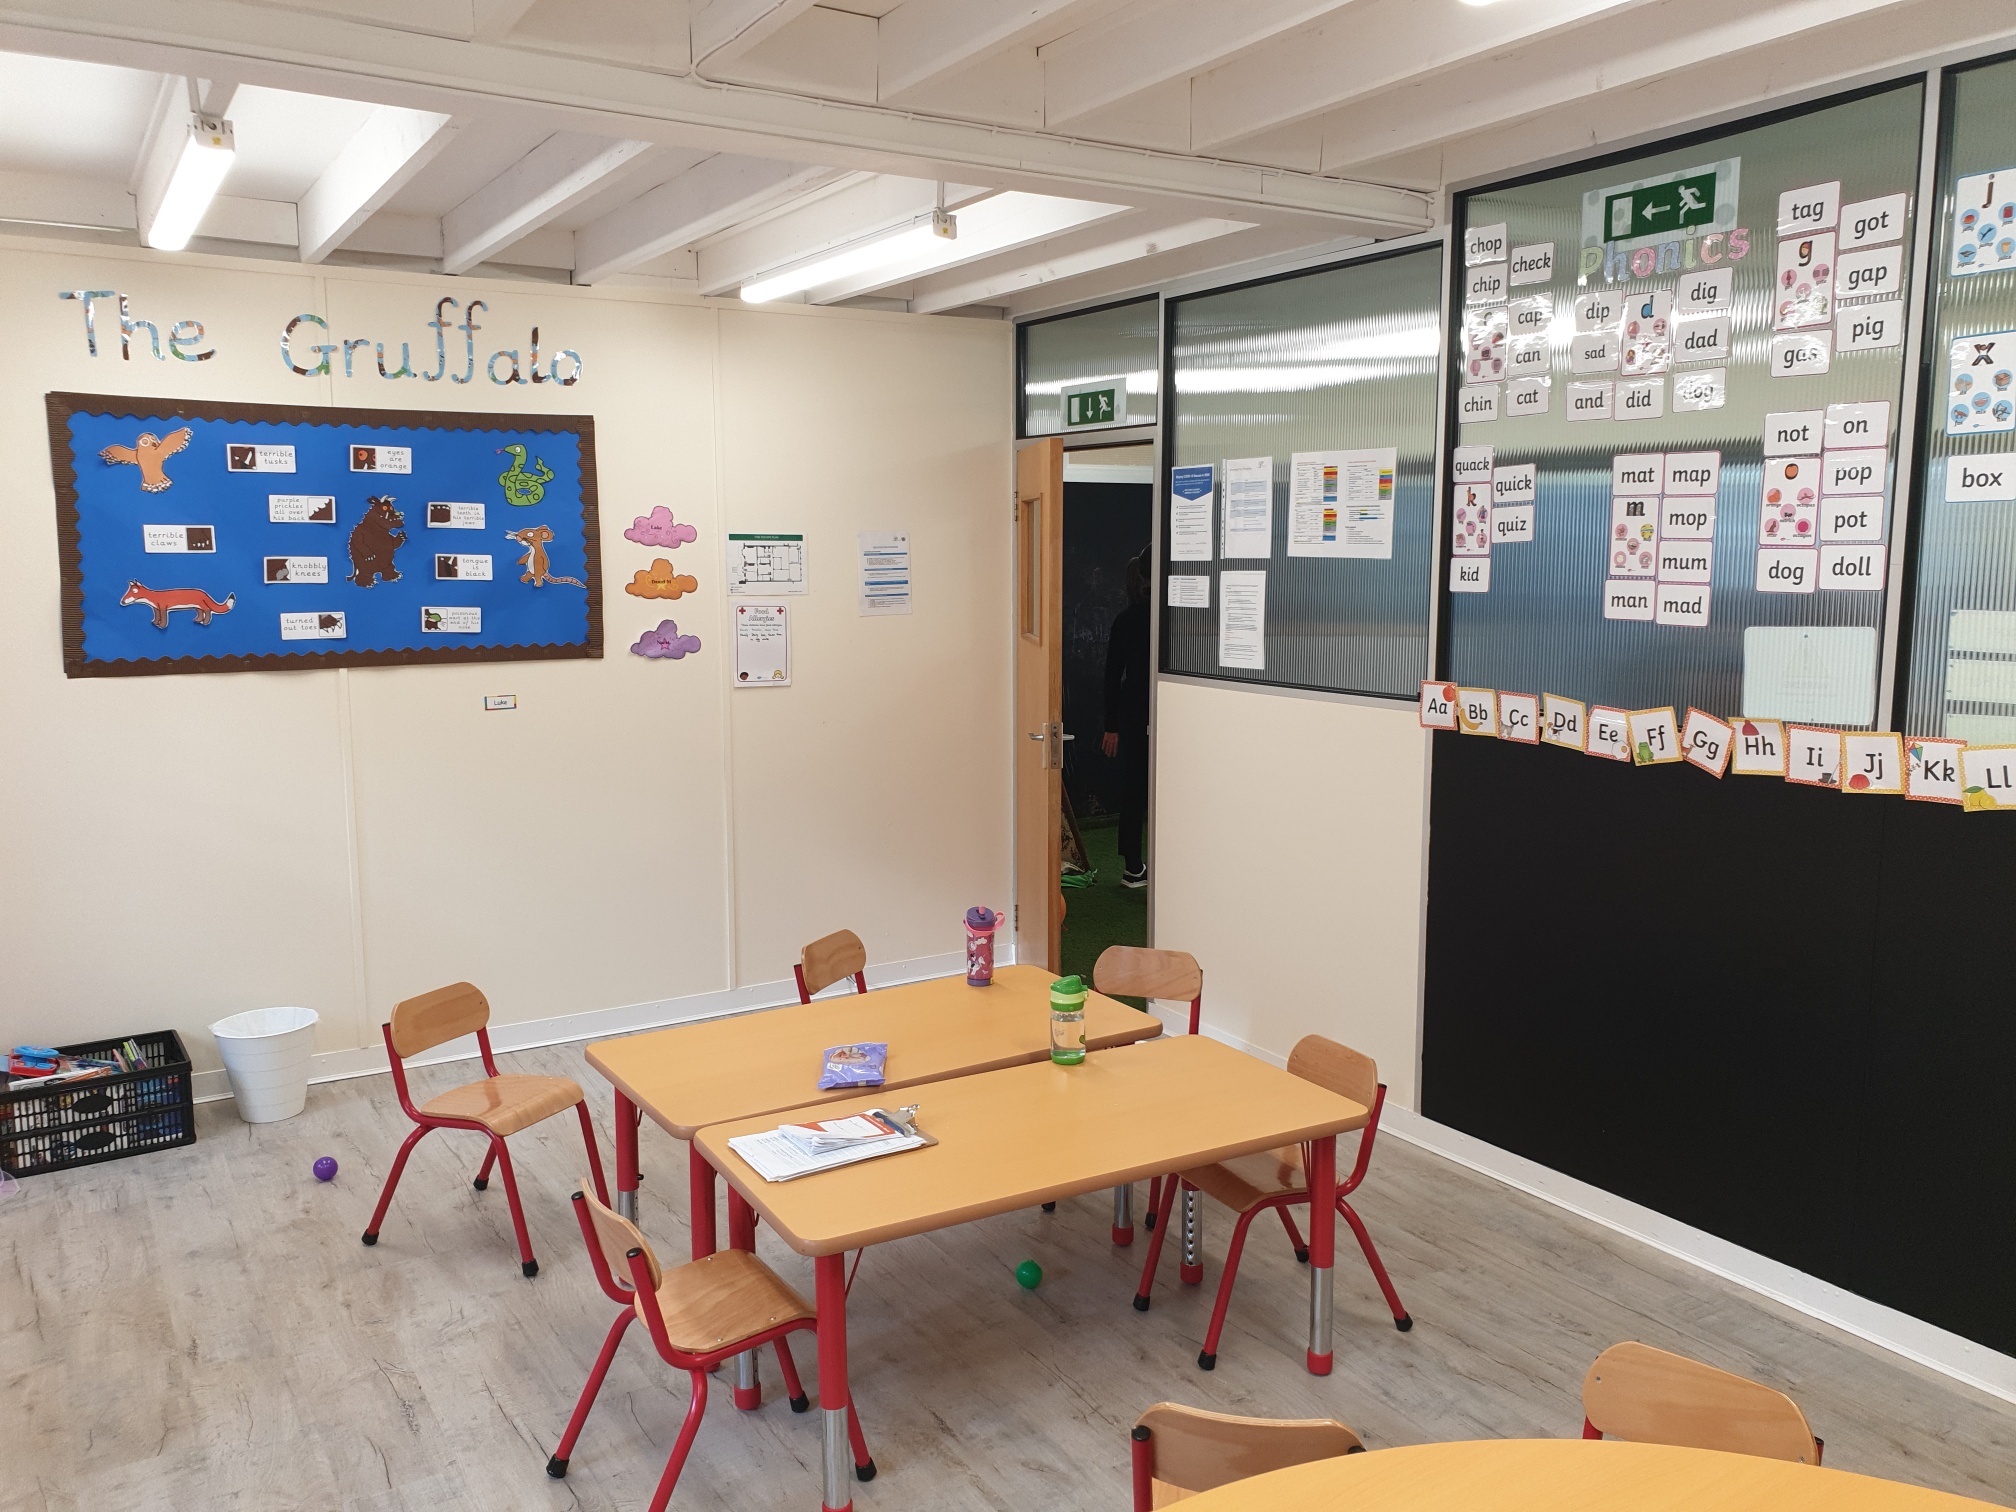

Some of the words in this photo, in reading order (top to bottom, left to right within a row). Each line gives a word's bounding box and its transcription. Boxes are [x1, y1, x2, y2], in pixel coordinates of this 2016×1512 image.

[1982, 174, 1994, 208] j
[1792, 201, 1824, 222] tag
[1854, 211, 1889, 239] got
[1470, 236, 1502, 254] chop
[1798, 241, 1813, 266] g
[1512, 252, 1551, 273] check
[1472, 276, 1501, 294] chip
[1848, 266, 1888, 290] gap
[1691, 281, 1718, 304] dig
[1586, 302, 1610, 322] dip
[1640, 295, 1654, 318] d
[1518, 310, 1542, 327] cap
[58, 290, 217, 362] The
[280, 296, 583, 387] Gruffalo
[1685, 328, 1718, 350] dad
[1852, 316, 1884, 342] pig
[1515, 348, 1541, 364] can
[1584, 344, 1606, 360] sad
[1784, 347, 1818, 368] gas
[1464, 397, 1492, 412] chin
[1516, 389, 1538, 405] cat
[1574, 392, 1604, 410] and
[1626, 390, 1652, 408] did
[1778, 426, 1810, 442] not
[1843, 420, 1868, 434] on
[1455, 457, 1490, 473] quack
[1835, 464, 1872, 486] pop
[1496, 474, 1532, 496] quick
[1621, 468, 1655, 484] mat
[1672, 468, 1711, 488] map
[1962, 468, 2003, 488] box
[1626, 501, 1645, 516] m
[1498, 516, 1526, 536] quiz
[1669, 512, 1708, 530] mop
[1834, 510, 1868, 533] pot
[292, 562, 326, 571] knobbly
[1662, 556, 1708, 570] mum
[1768, 560, 1804, 585] dog
[1832, 556, 1872, 576] doll
[1460, 566, 1480, 582] kid
[1611, 594, 1648, 608] man
[1663, 596, 1702, 614] mad
[1427, 698, 1448, 716] Aa
[1468, 704, 1488, 721] Bb
[1509, 709, 1529, 727] Cc
[1553, 712, 1578, 732] Dd
[1599, 724, 1618, 742] Ee
[1646, 725, 1666, 750] Ff
[1692, 730, 1720, 760] Gg
[1744, 736, 1776, 756] Hh
[1806, 746, 1824, 768] Ii
[1864, 753, 1884, 780] Jj
[1924, 760, 1956, 782] Kk
[1986, 765, 2012, 789] Ll
